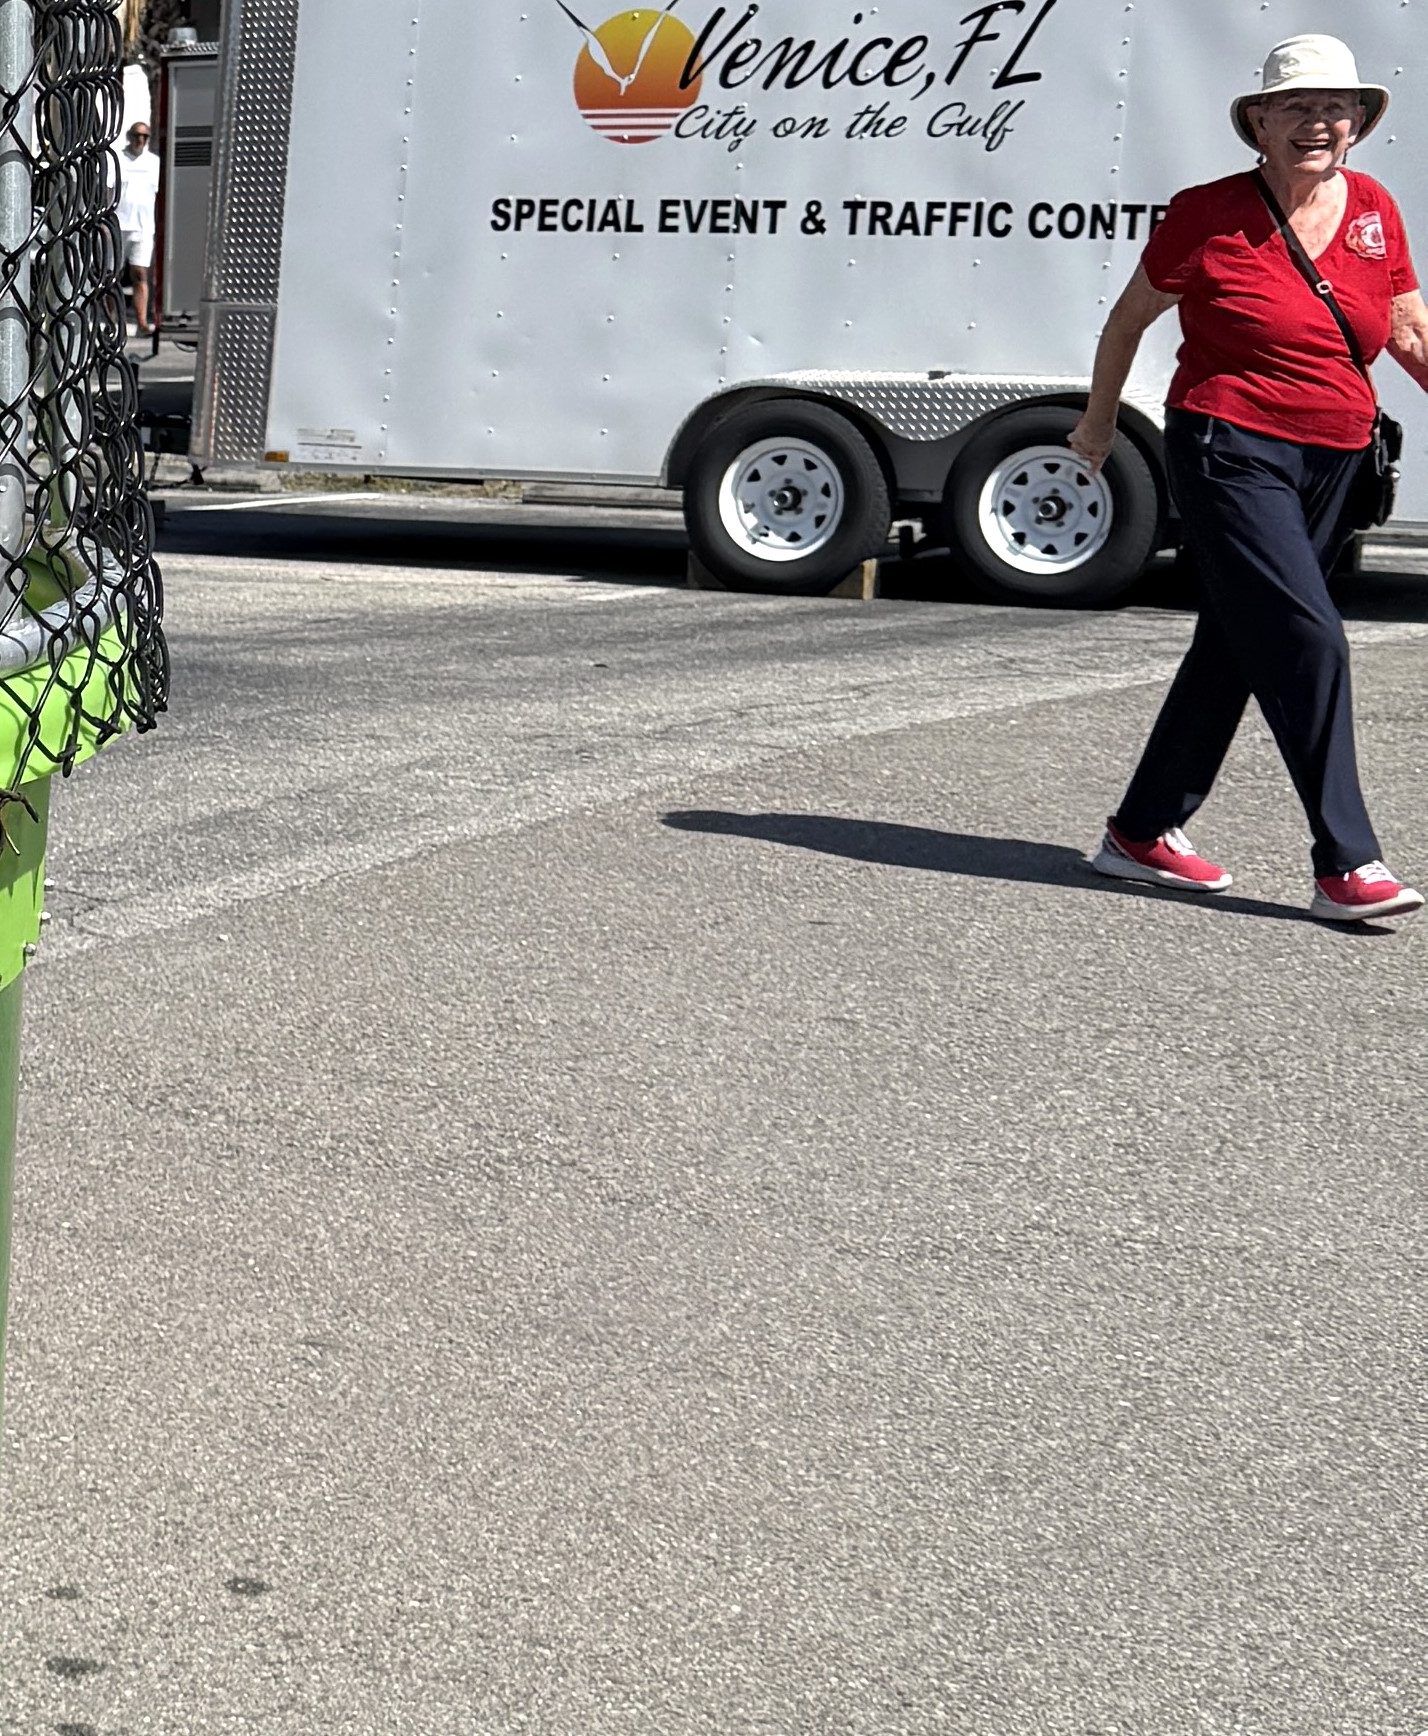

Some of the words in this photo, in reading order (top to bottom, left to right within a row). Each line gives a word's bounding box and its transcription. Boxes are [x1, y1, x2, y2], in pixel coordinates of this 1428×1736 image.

[674, 104, 757, 152] City
[772, 116, 831, 139] on
[844, 101, 907, 140] the
[926, 100, 1026, 153] Gulf
[490, 198, 644, 232] SPECIAL
[657, 199, 787, 234] EVENT
[800, 200, 827, 235] &
[843, 200, 1013, 238] TRAFFIC
